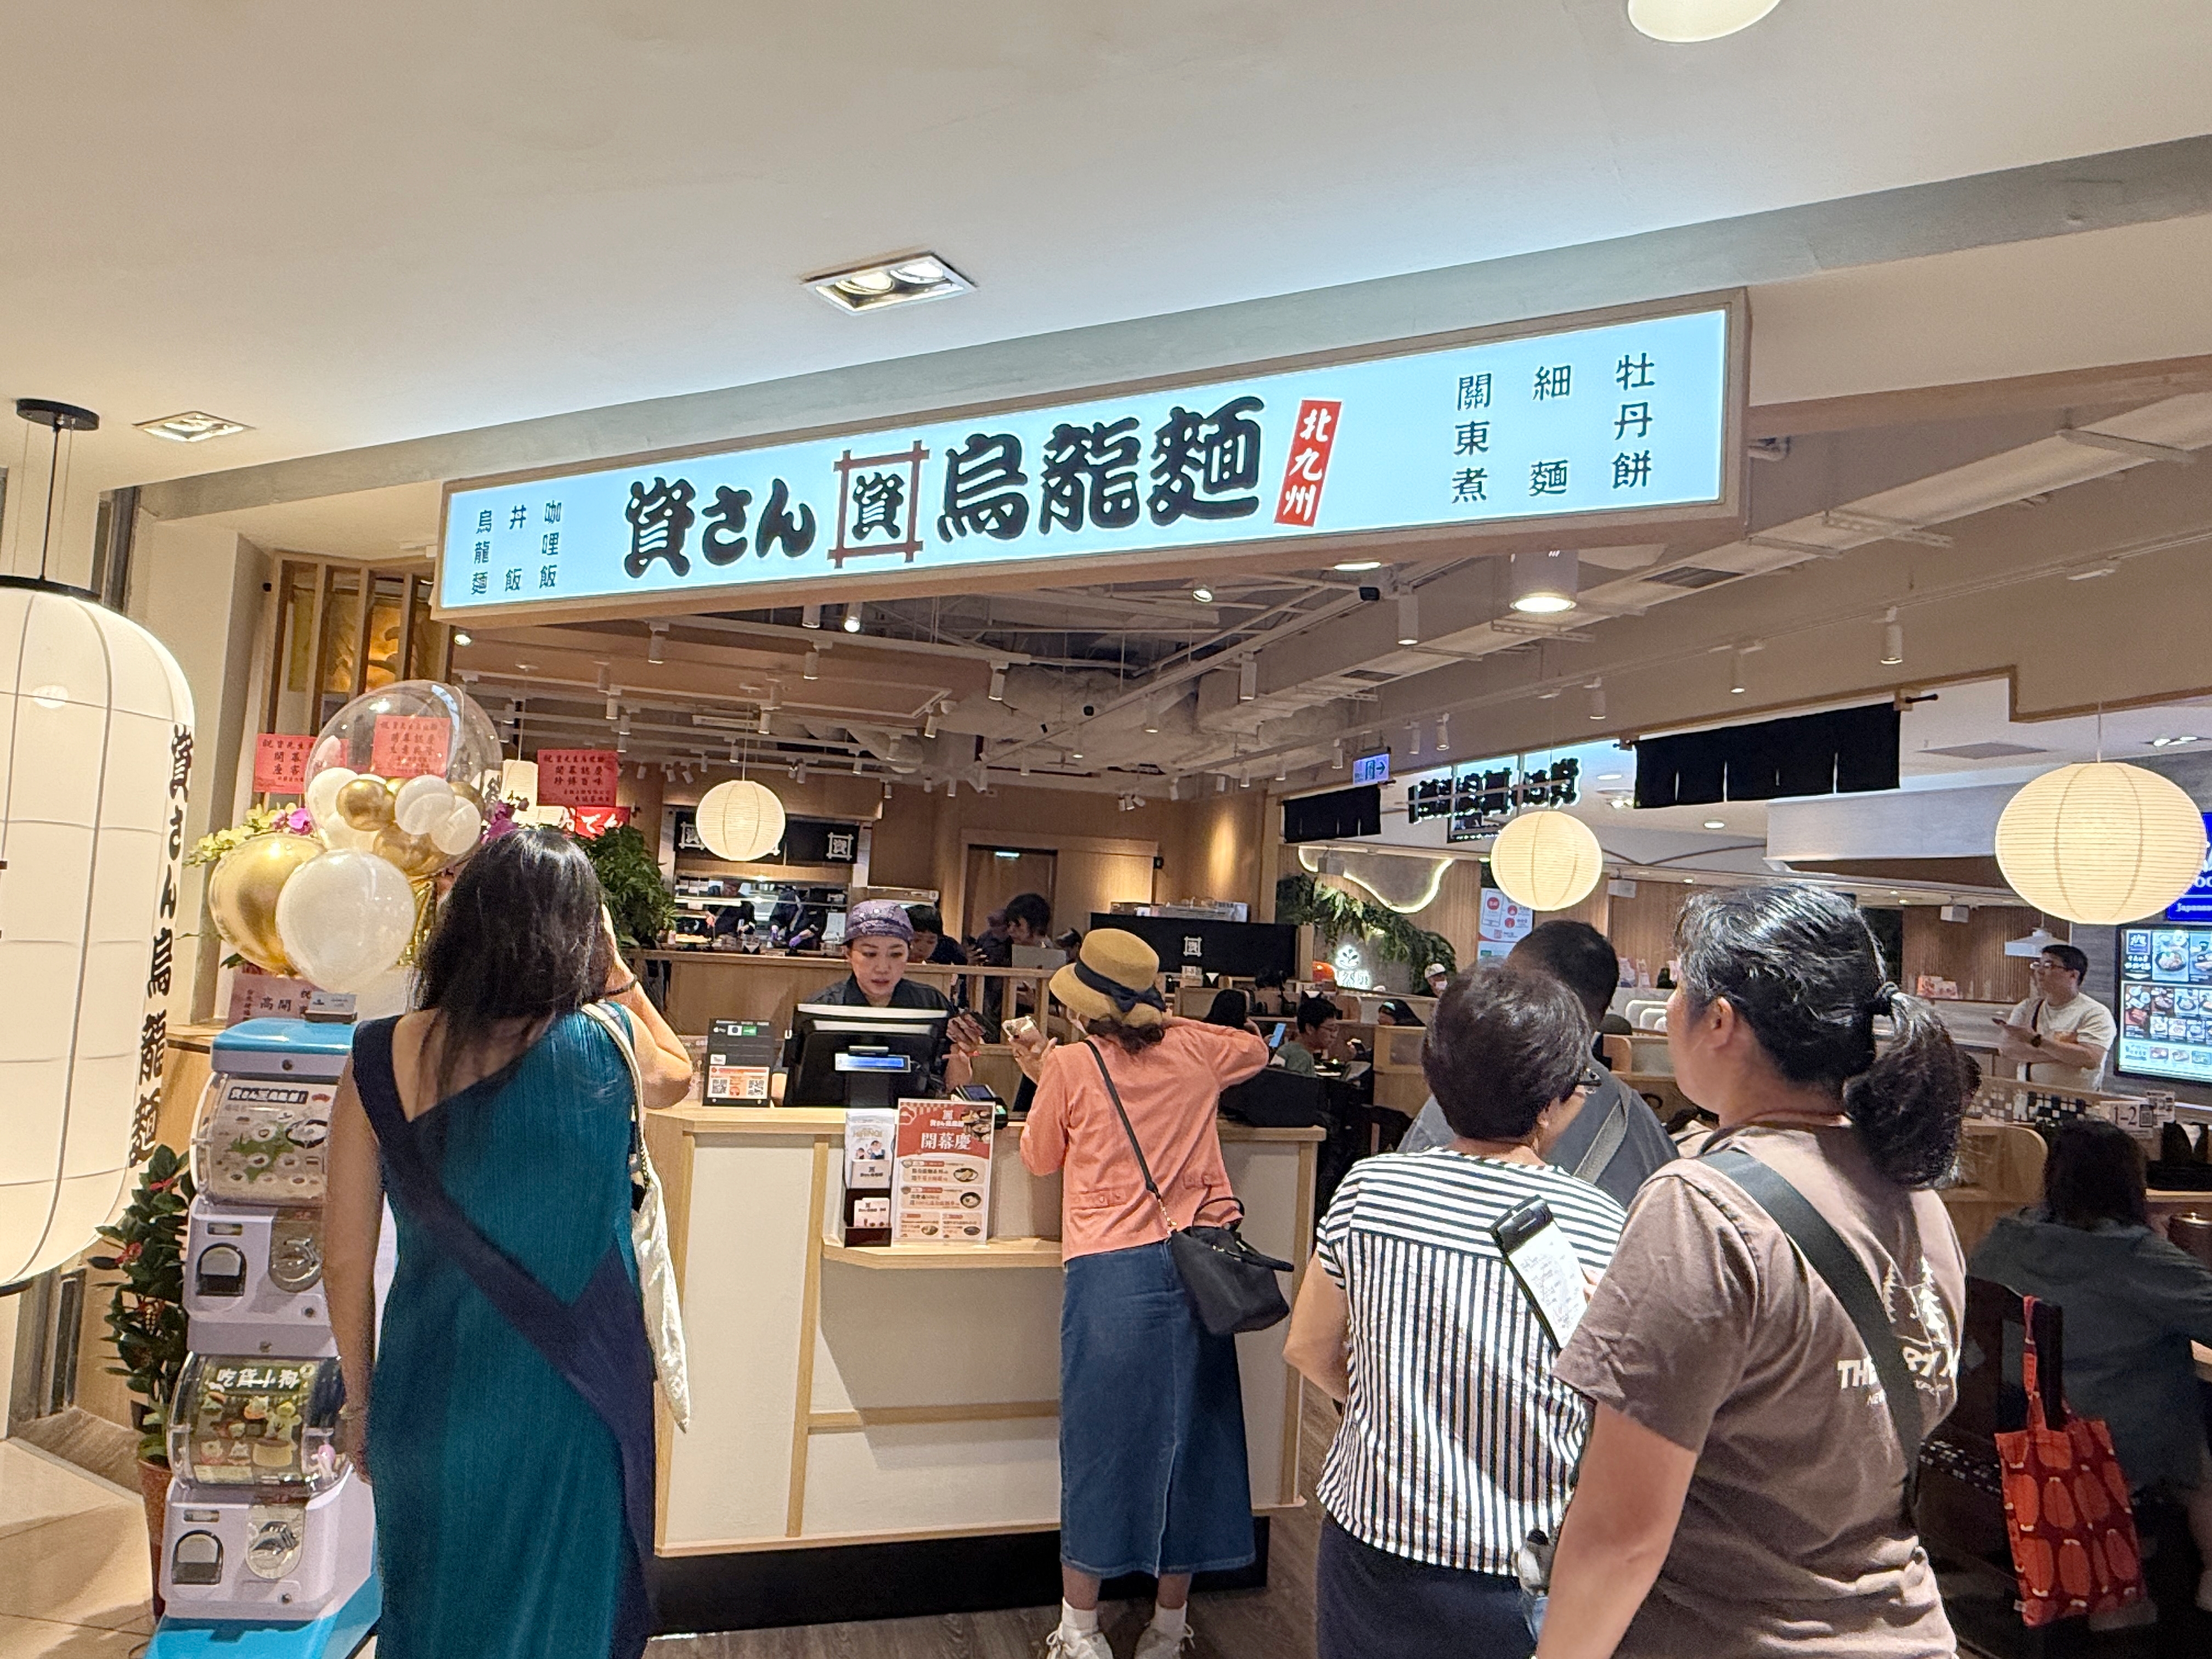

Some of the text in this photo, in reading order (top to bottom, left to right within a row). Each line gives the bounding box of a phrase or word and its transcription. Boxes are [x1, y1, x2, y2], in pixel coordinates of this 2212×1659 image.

[1284, 408, 1332, 522] 北九州
[1452, 373, 1492, 504] 關東煮
[1529, 365, 1571, 496] 細麵
[1611, 352, 1655, 489] 牡丹餅
[539, 499, 561, 589] 咖哩飯
[623, 477, 816, 578] 資さん
[936, 396, 1265, 543] 烏龍麵
[471, 509, 493, 595] 烏龍麵
[505, 505, 527, 592] 丼飯
[129, 724, 194, 1169] 資さん烏龍麵
[921, 1132, 972, 1150] 開幕慶
[2114, 1105, 2137, 1126] 1-2
